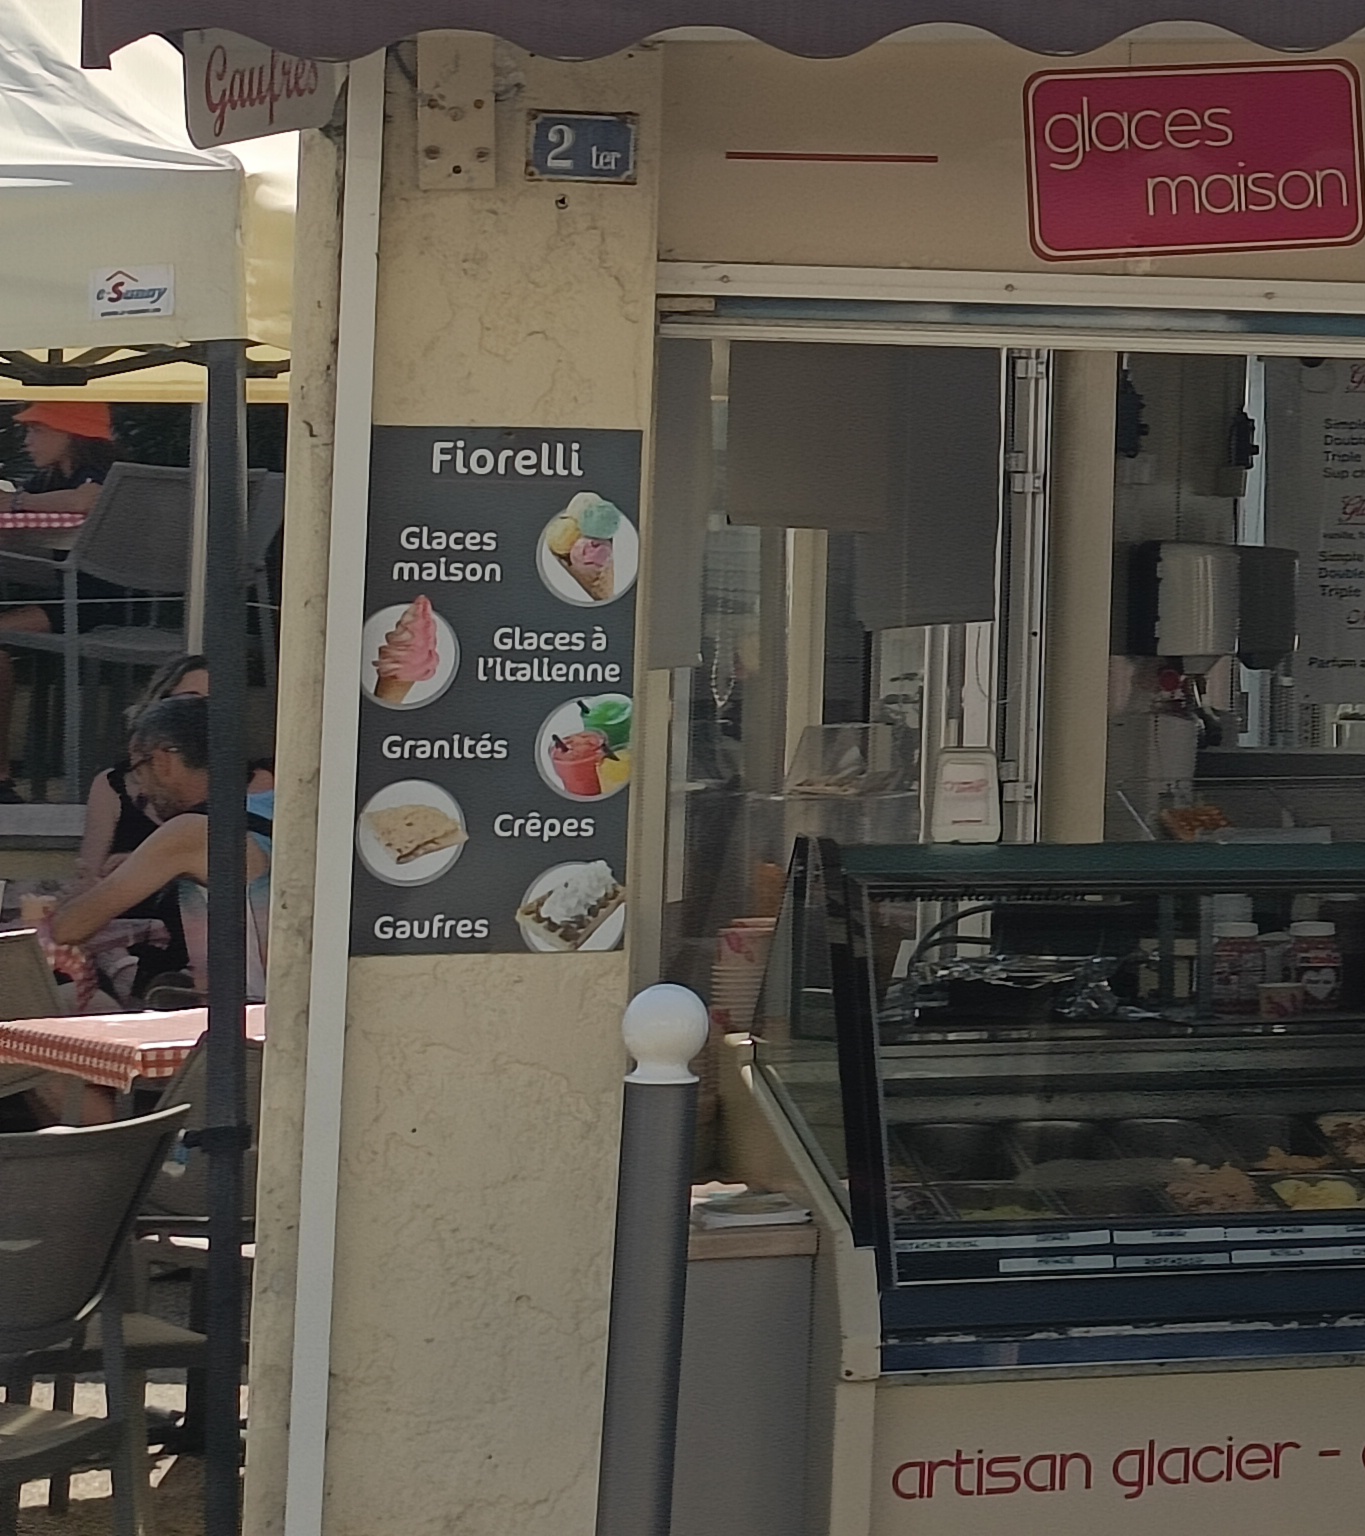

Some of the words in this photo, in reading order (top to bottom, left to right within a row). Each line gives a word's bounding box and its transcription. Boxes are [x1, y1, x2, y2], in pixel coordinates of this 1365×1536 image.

[204, 45, 319, 137] Gaufres
[546, 125, 574, 171] 2
[591, 143, 622, 171] ter
[1044, 96, 1234, 170] glaces
[1145, 161, 1349, 216] maison
[431, 440, 584, 477] Fiorelli
[400, 526, 497, 551] Glaces
[392, 557, 502, 582] maison
[493, 626, 585, 651] Glaces
[593, 626, 608, 651] à
[382, 734, 508, 760] Granités
[494, 811, 595, 842] Crêpes
[374, 915, 489, 940] Gaufres
[891, 1447, 1093, 1499] artisan
[1111, 1436, 1302, 1498] glacier
